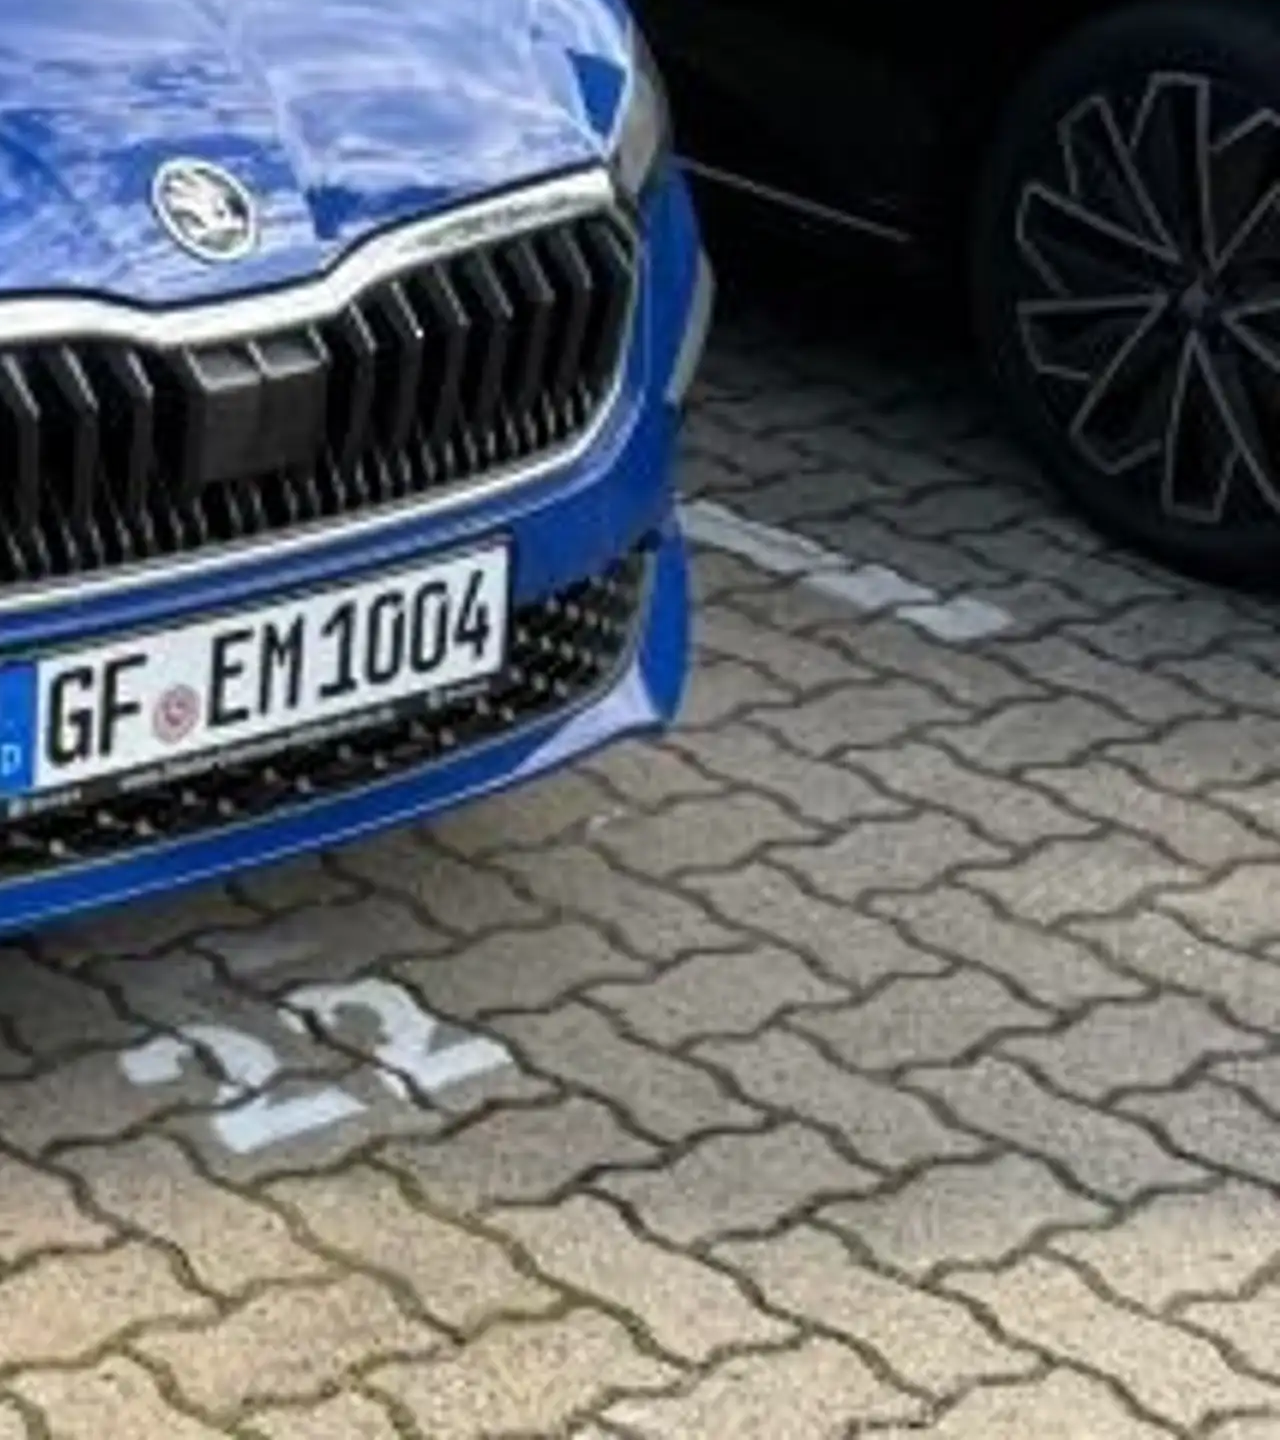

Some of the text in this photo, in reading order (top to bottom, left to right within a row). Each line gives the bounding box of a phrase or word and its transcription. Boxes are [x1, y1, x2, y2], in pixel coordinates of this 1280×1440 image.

[0, 742, 22, 777] D
[46, 654, 148, 767] GF
[119, 976, 516, 1154] 22
